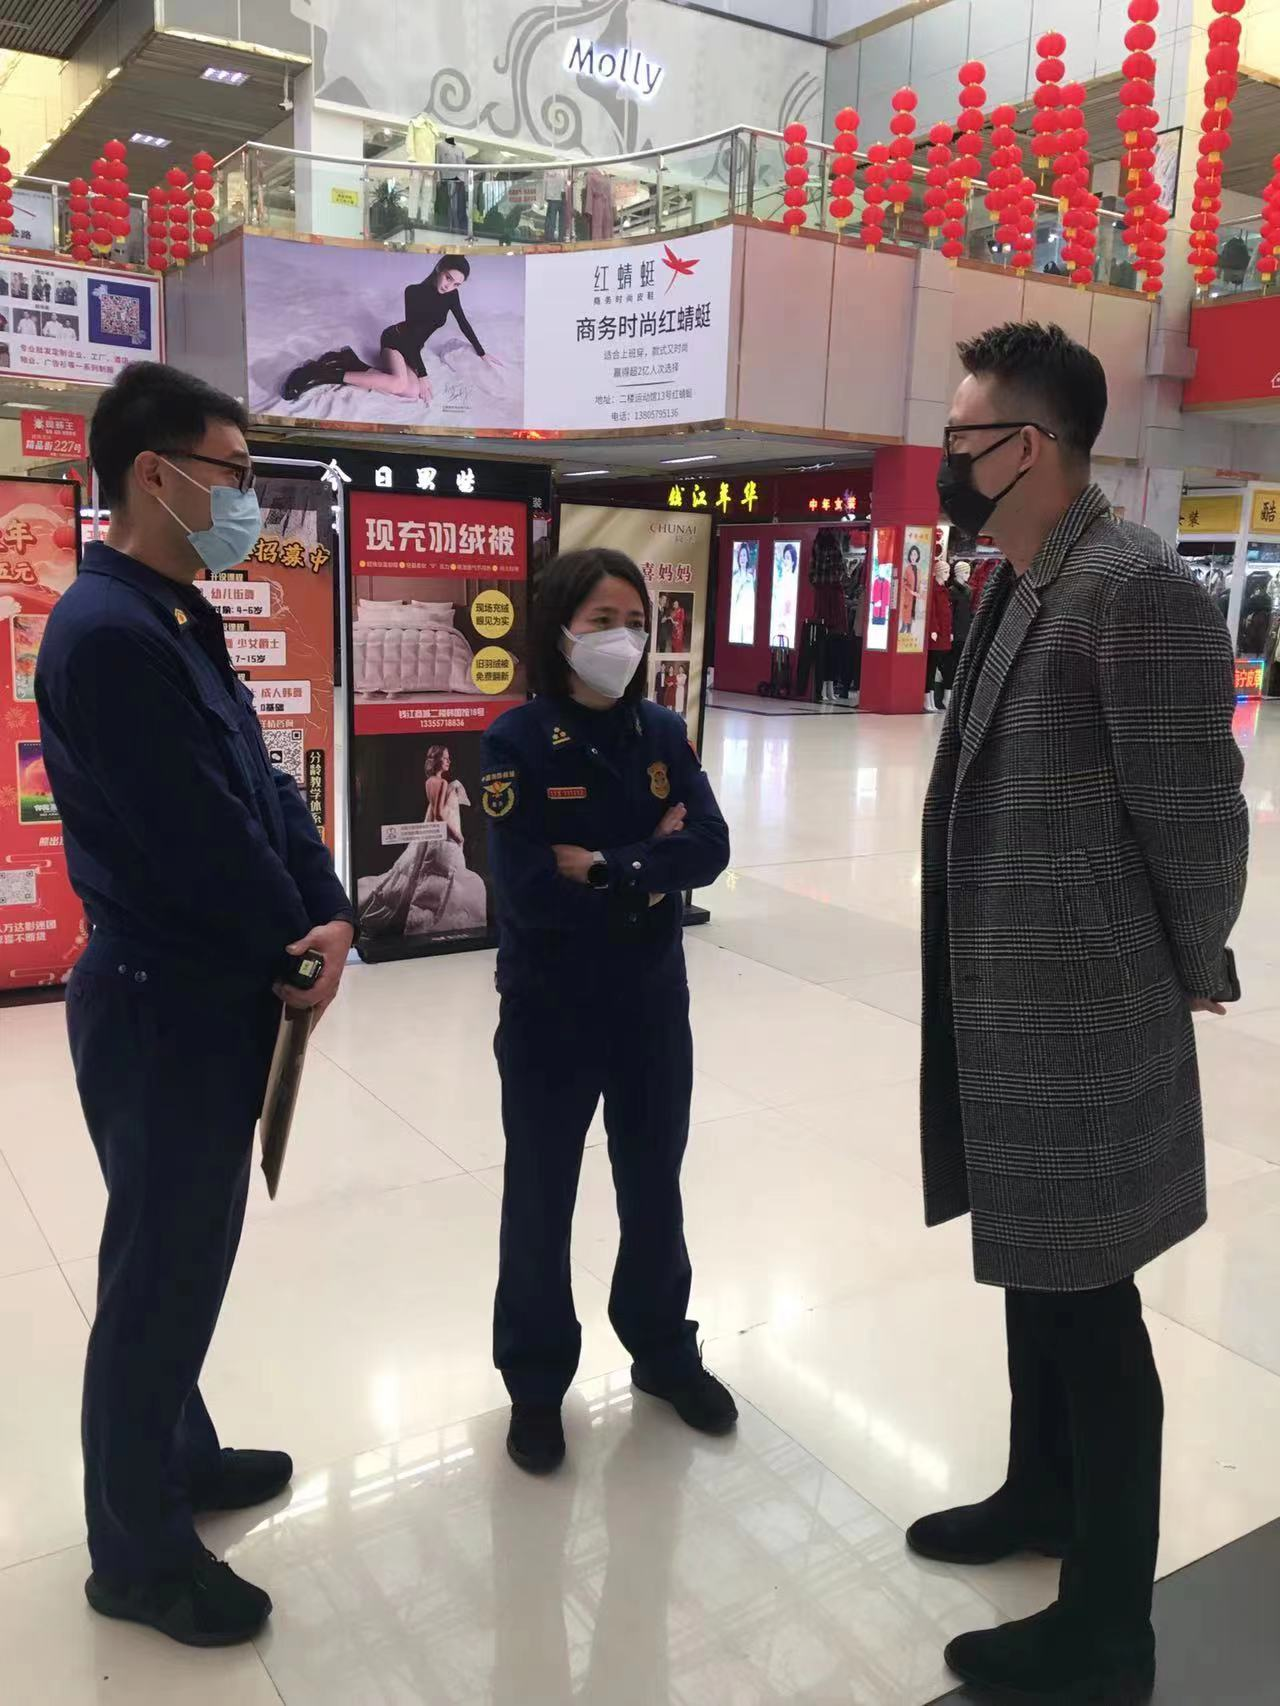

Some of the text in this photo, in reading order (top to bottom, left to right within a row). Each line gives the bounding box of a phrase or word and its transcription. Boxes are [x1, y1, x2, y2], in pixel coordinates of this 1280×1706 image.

[568, 37, 662, 95] Molly
[593, 260, 656, 292] 红蜻蜓
[593, 291, 655, 306] 商务时尚皮鞋
[576, 301, 712, 343] 商务时尚红蜻蜓
[613, 362, 680, 379] 赢得超2亿人次选择
[666, 480, 760, 513] 钱江年华
[365, 518, 515, 556] 现充羽绒被
[475, 616, 510, 626] 眼见为实
[237, 638, 280, 649] 少女爵士
